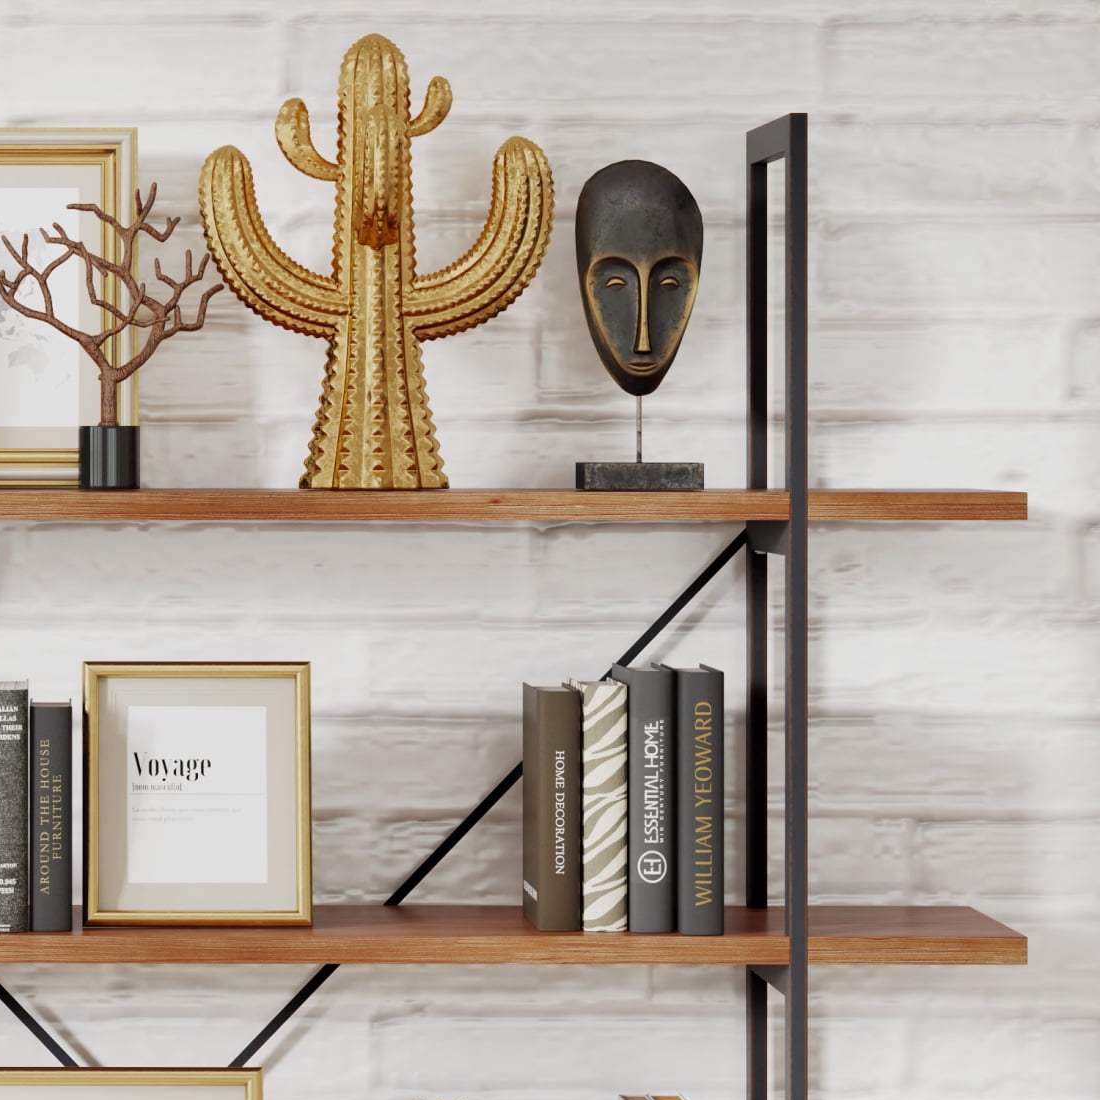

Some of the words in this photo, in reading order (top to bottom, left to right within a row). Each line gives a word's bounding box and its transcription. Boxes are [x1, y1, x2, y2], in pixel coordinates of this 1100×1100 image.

[40, 739, 50, 789] HOUSE
[133, 752, 212, 782] Voyage
[555, 750, 565, 789] HOME
[644, 720, 659, 768] HOME
[695, 701, 712, 808] YEOWARD
[40, 795, 50, 825] THE
[52, 774, 62, 859] FURNITURE
[555, 791, 565, 875] DECORATION
[644, 771, 659, 844] ESSENTIAL
[40, 831, 50, 895] AROUND
[695, 816, 712, 906] WILLIAM
